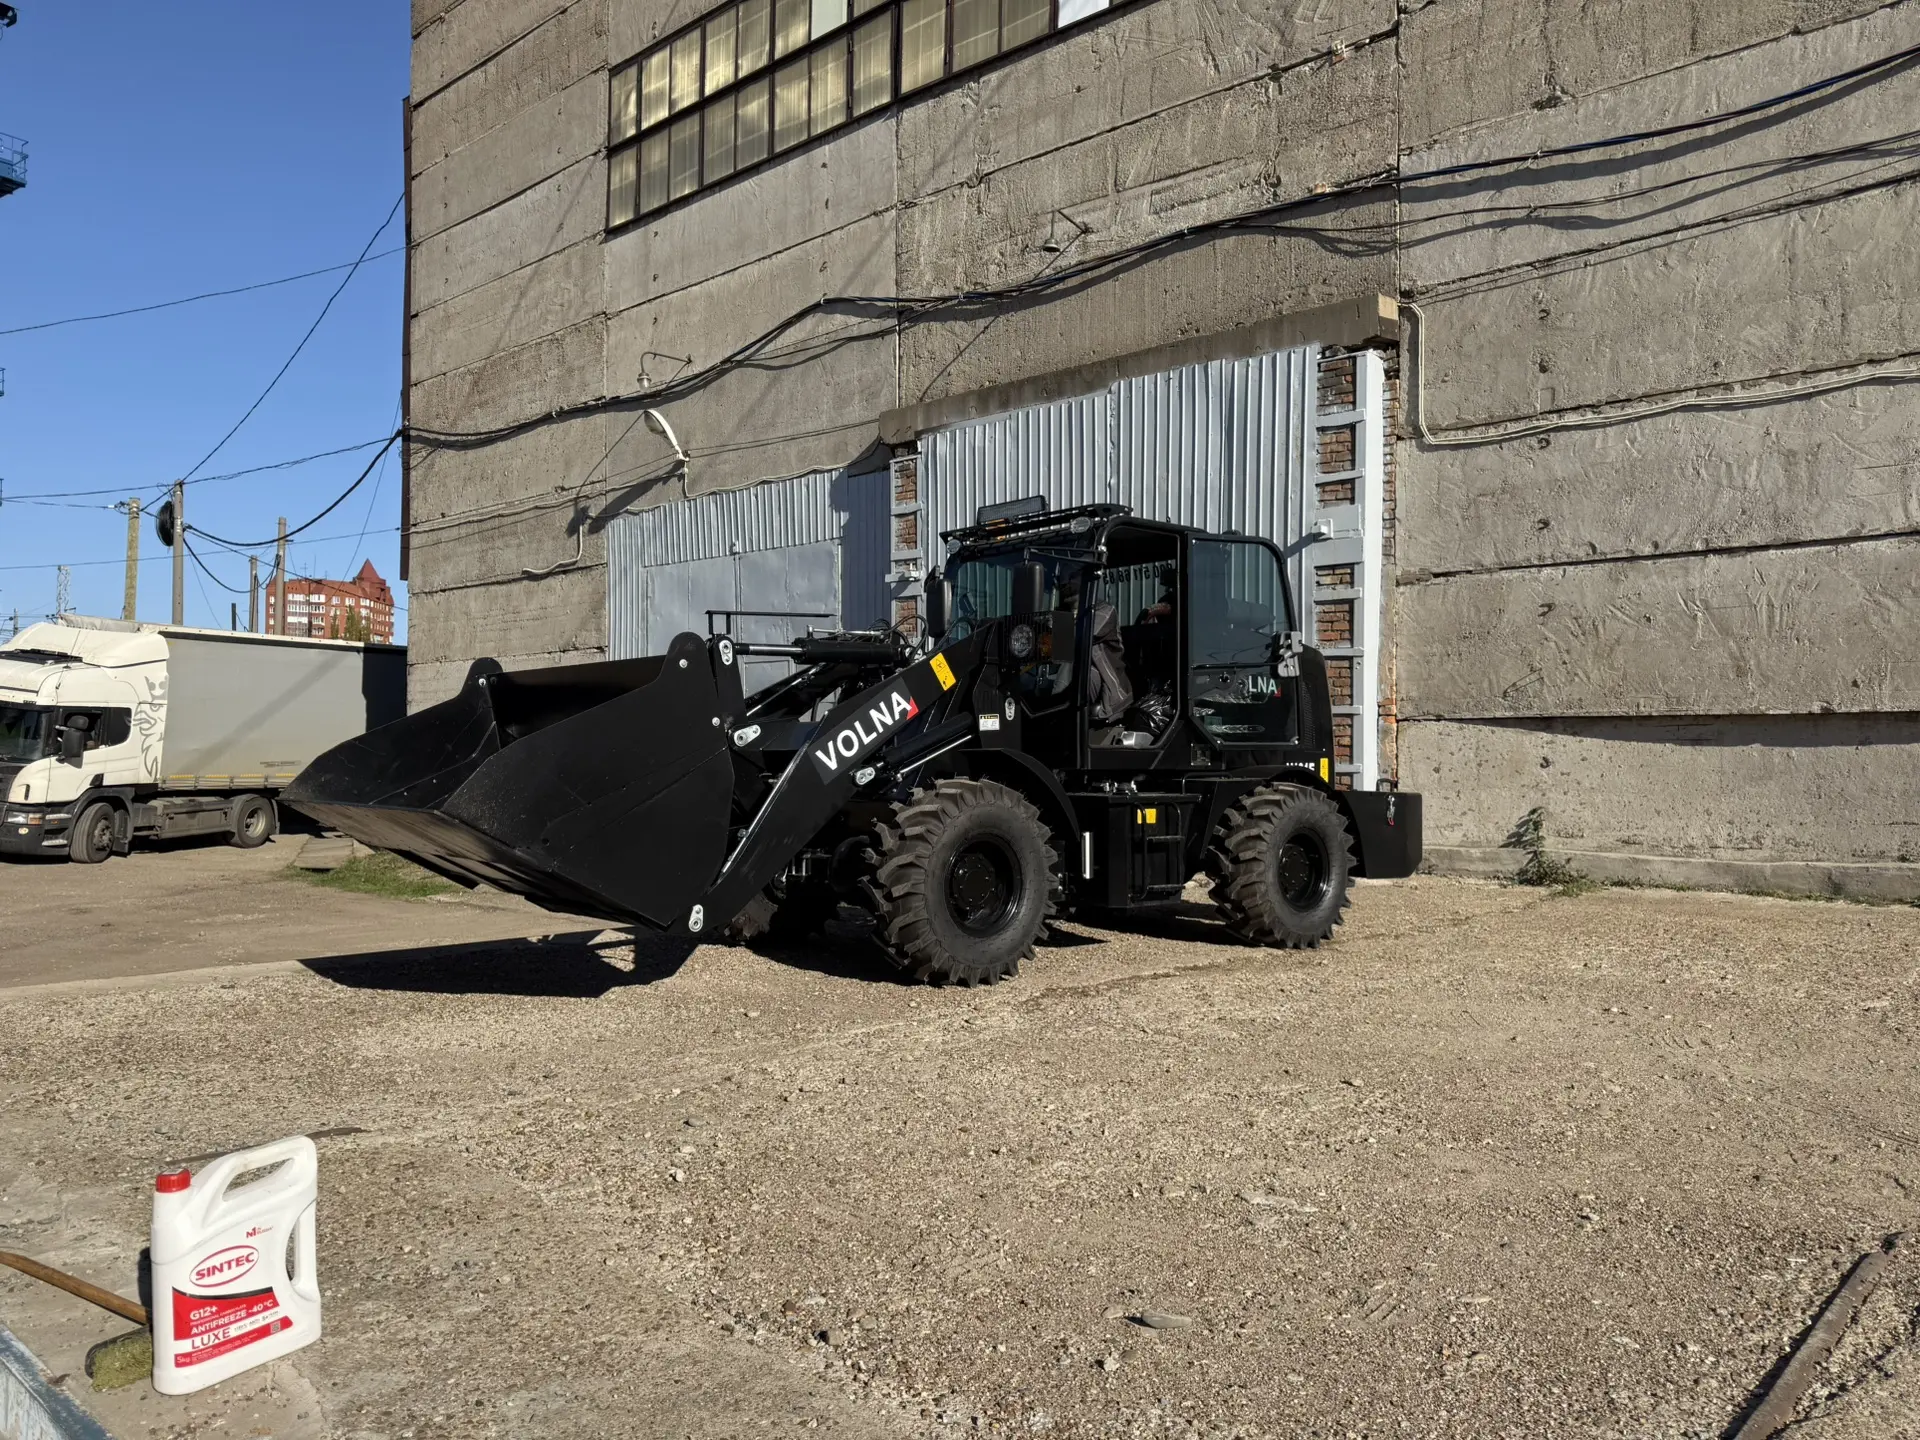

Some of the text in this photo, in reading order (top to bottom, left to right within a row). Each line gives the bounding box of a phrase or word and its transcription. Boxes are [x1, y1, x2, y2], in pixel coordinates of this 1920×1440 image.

[1248, 675, 1278, 694] LNA
[815, 691, 912, 771] VOLNA
[195, 1252, 255, 1281] SINTEC
[190, 1305, 218, 1320] G12+
[191, 1309, 247, 1335] ANTIFREEZE
[191, 1327, 231, 1350] LUXE
